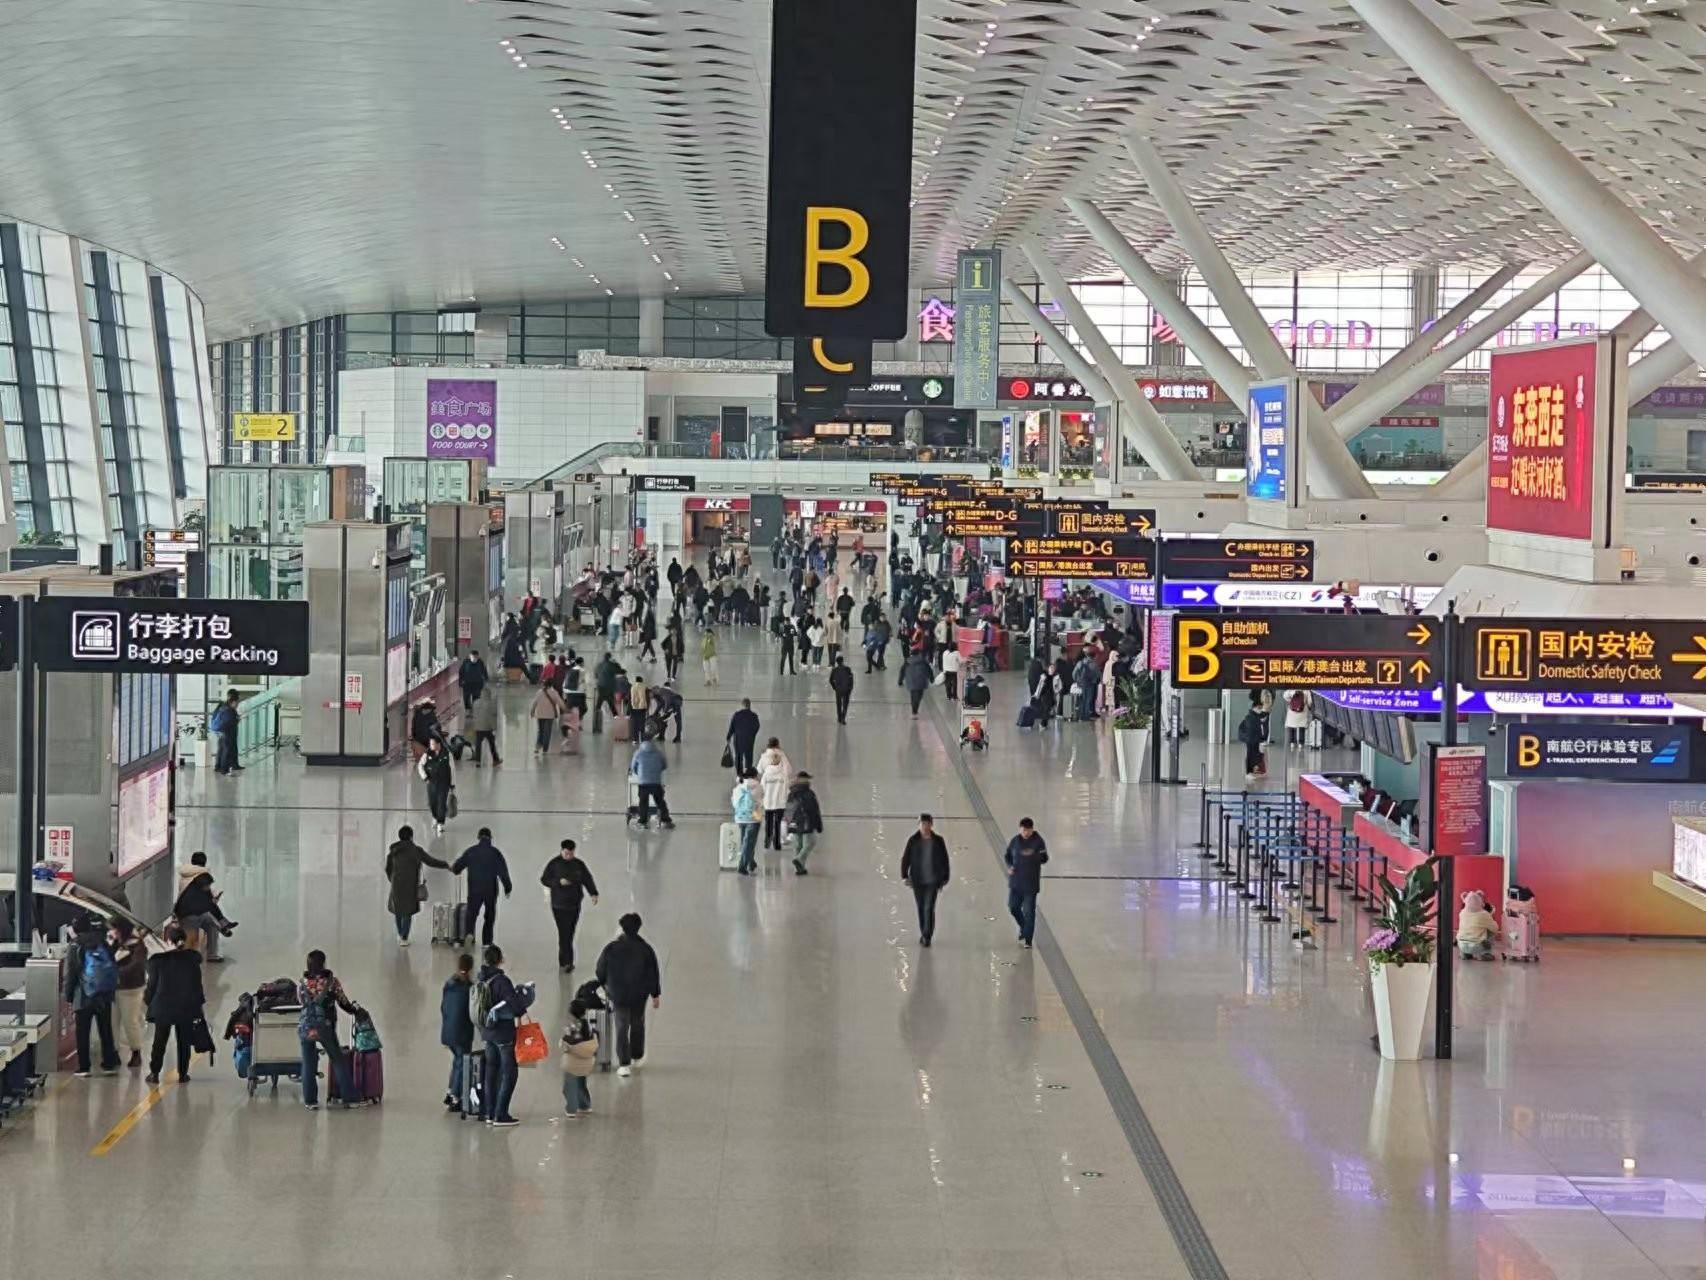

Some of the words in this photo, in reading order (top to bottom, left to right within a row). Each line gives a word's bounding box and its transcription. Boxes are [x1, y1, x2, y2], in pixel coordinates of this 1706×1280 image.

[804, 207, 869, 307] B
[918, 296, 955, 341] 食
[977, 304, 992, 401] 旅客服务中心
[430, 395, 492, 416] 美食广场
[1512, 384, 1565, 447] 东奔西走
[277, 418, 288, 435] 2
[432, 441, 453, 449] FOOD
[454, 441, 479, 449] COURT
[704, 499, 732, 509] KFC
[996, 510, 1018, 520] D-G
[1081, 513, 1126, 525] 国内安检
[1083, 540, 1113, 555] D-G
[1225, 542, 1236, 557] C
[1251, 564, 1279, 572] 国内出发
[128, 613, 232, 639] 行李打包
[1222, 621, 1270, 635] 自助值机
[1222, 637, 1234, 645] Self
[1539, 630, 1655, 659] 国内安检
[128, 644, 205, 666] Baggage
[210, 645, 278, 665] Packing
[1178, 619, 1220, 682] B
[1269, 659, 1367, 673] 国际/港澳台出发
[1538, 663, 1590, 680] Domestic
[1592, 663, 1627, 683] Safety
[1628, 663, 1662, 681] Check
[1338, 675, 1374, 686] Departures
[1349, 695, 1393, 706] Self-service
[1394, 698, 1419, 707] Zone
[1518, 735, 1541, 766] B
